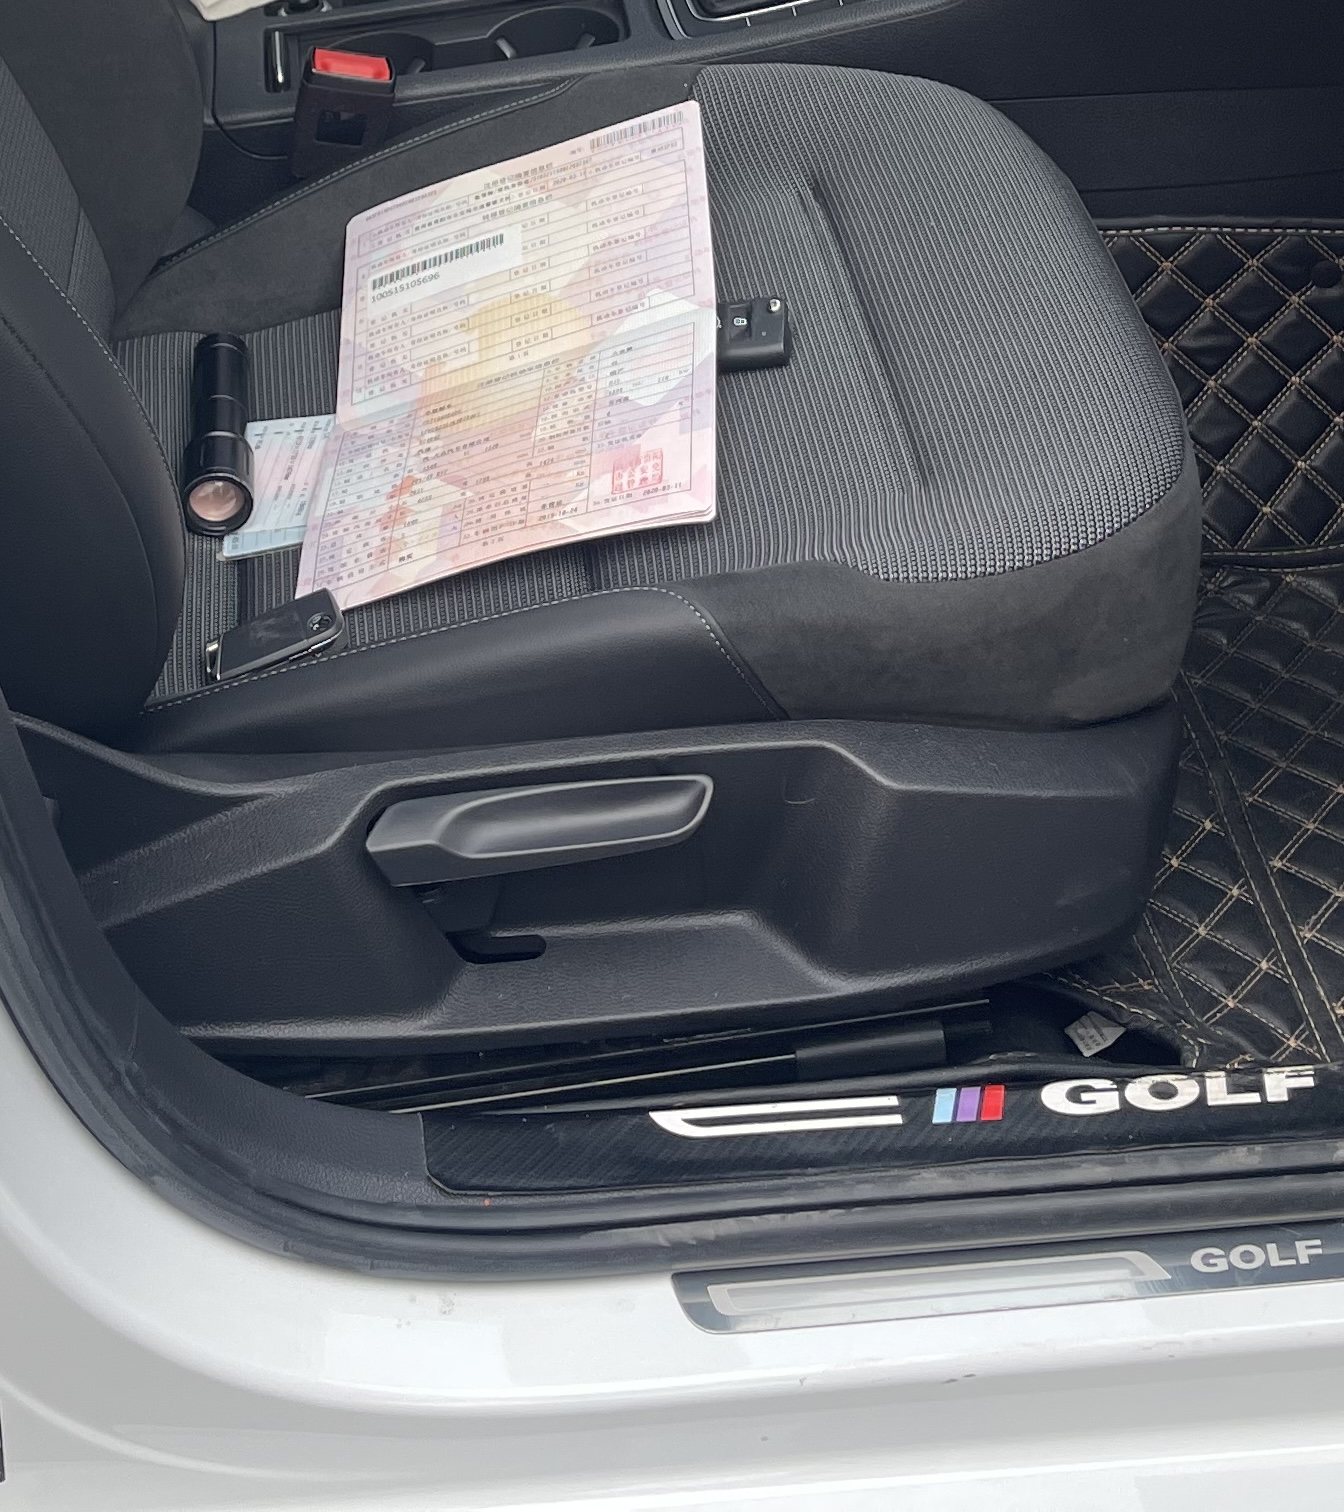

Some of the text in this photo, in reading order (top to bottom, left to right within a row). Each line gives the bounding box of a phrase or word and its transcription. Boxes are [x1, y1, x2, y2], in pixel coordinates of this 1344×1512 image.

[371, 271, 441, 304] 100515105696
[1041, 1065, 1315, 1115] GOLF
[1191, 1239, 1322, 1273] GOLF
